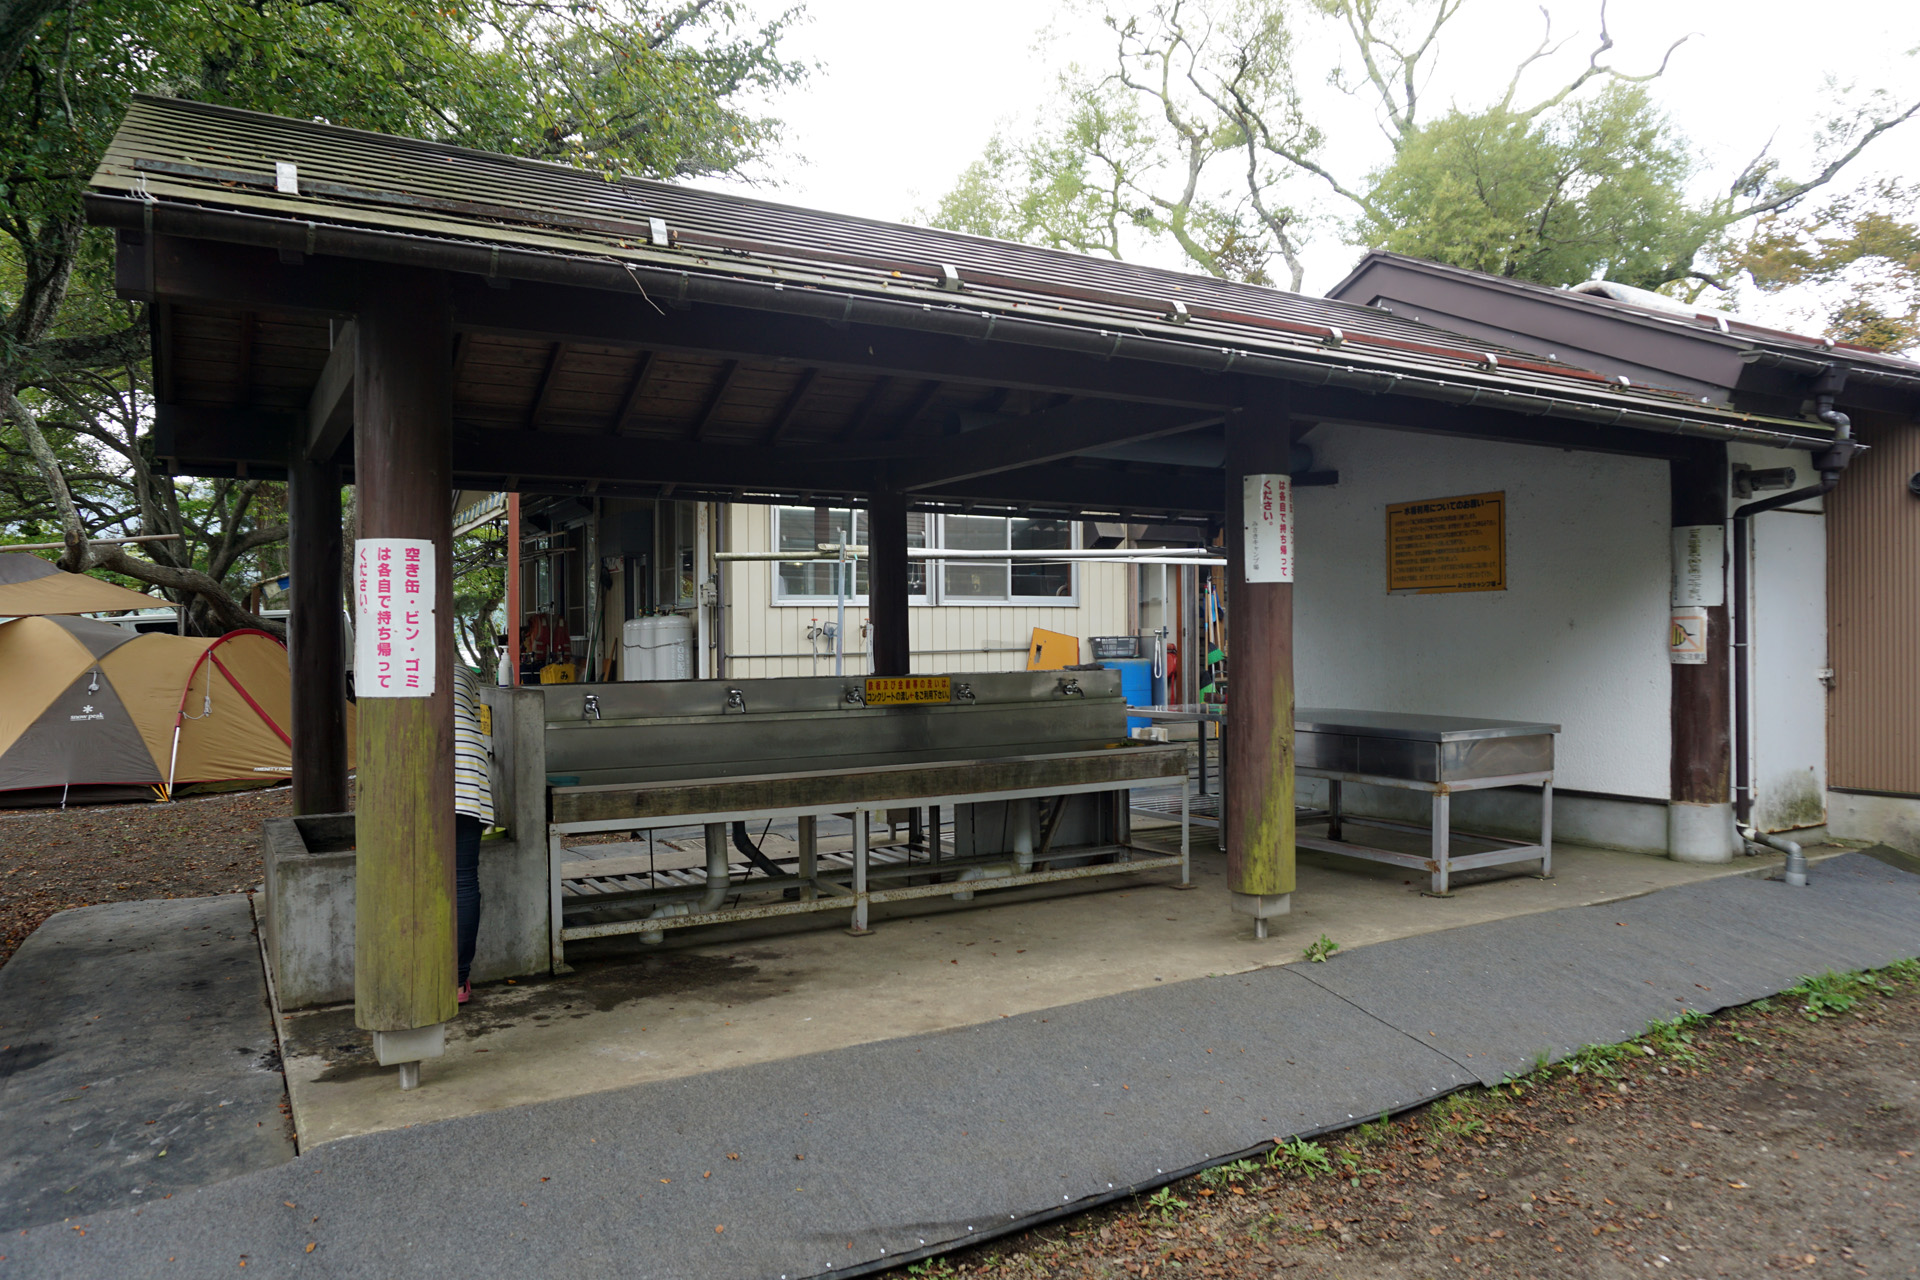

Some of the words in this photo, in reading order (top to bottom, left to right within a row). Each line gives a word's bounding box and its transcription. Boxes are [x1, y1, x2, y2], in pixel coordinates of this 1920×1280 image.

[1263, 480, 1273, 526] ください。
[1279, 480, 1287, 577] は各自で持ち帰って
[359, 547, 368, 614] ください。
[377, 547, 391, 688] は各自で持ち帰って
[404, 547, 420, 689] 空き缶・ビン・ゴミ
[87, 712, 104, 721] peak
